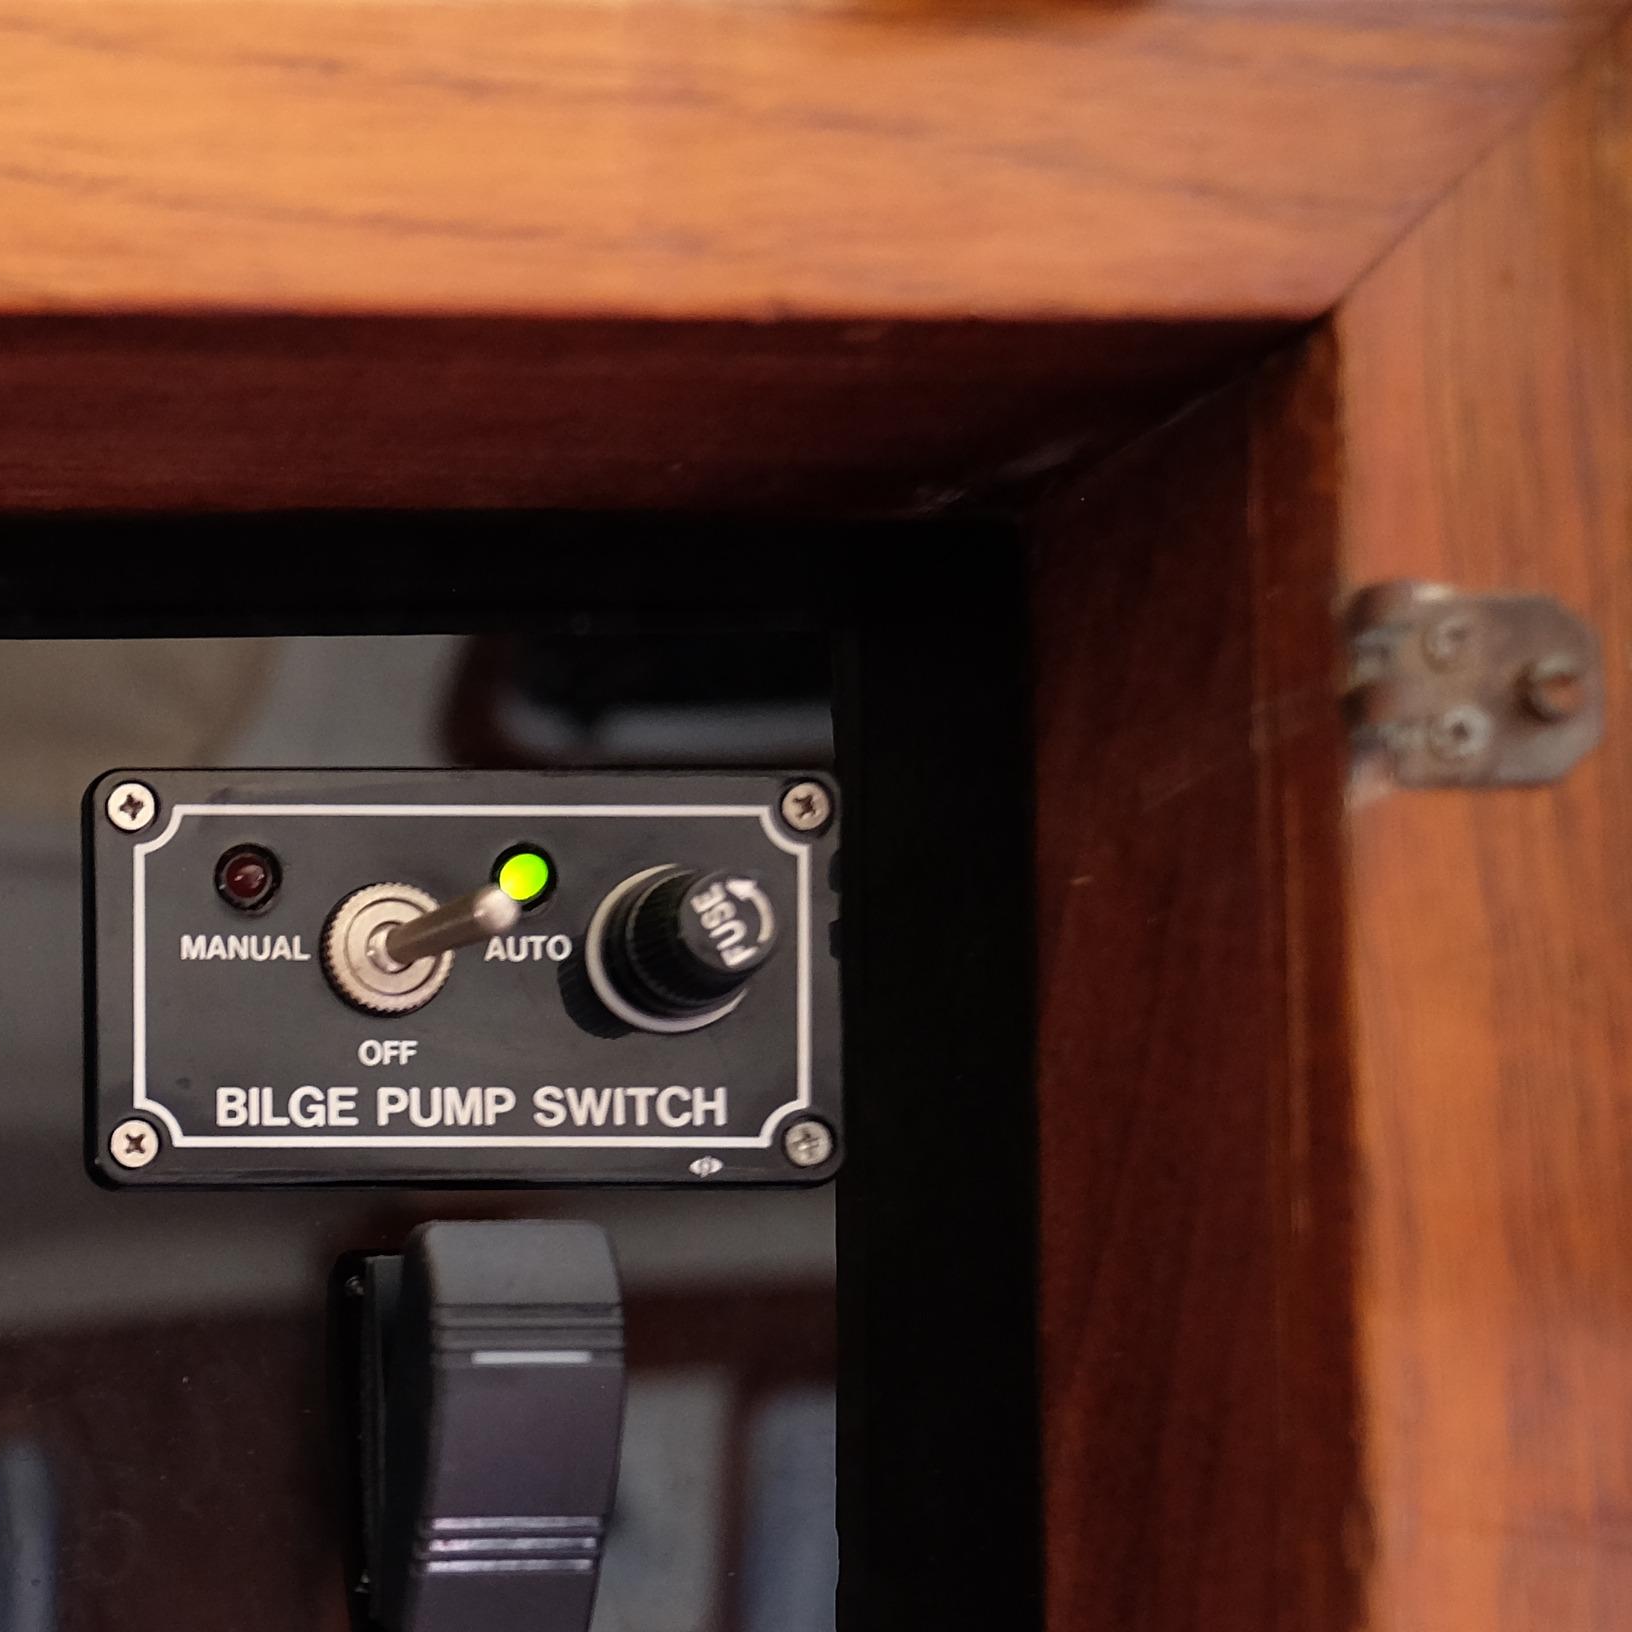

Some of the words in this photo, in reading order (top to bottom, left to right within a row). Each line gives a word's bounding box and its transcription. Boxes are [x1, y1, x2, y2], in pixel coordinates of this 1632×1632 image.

[690, 882, 759, 966] FUSE
[180, 935, 311, 961] MANUAL
[484, 934, 572, 962] AUTO
[358, 1040, 418, 1067] OFF
[215, 1087, 359, 1128] BILGE
[377, 1086, 517, 1127] PUMP
[533, 1085, 728, 1126] SWITCH
